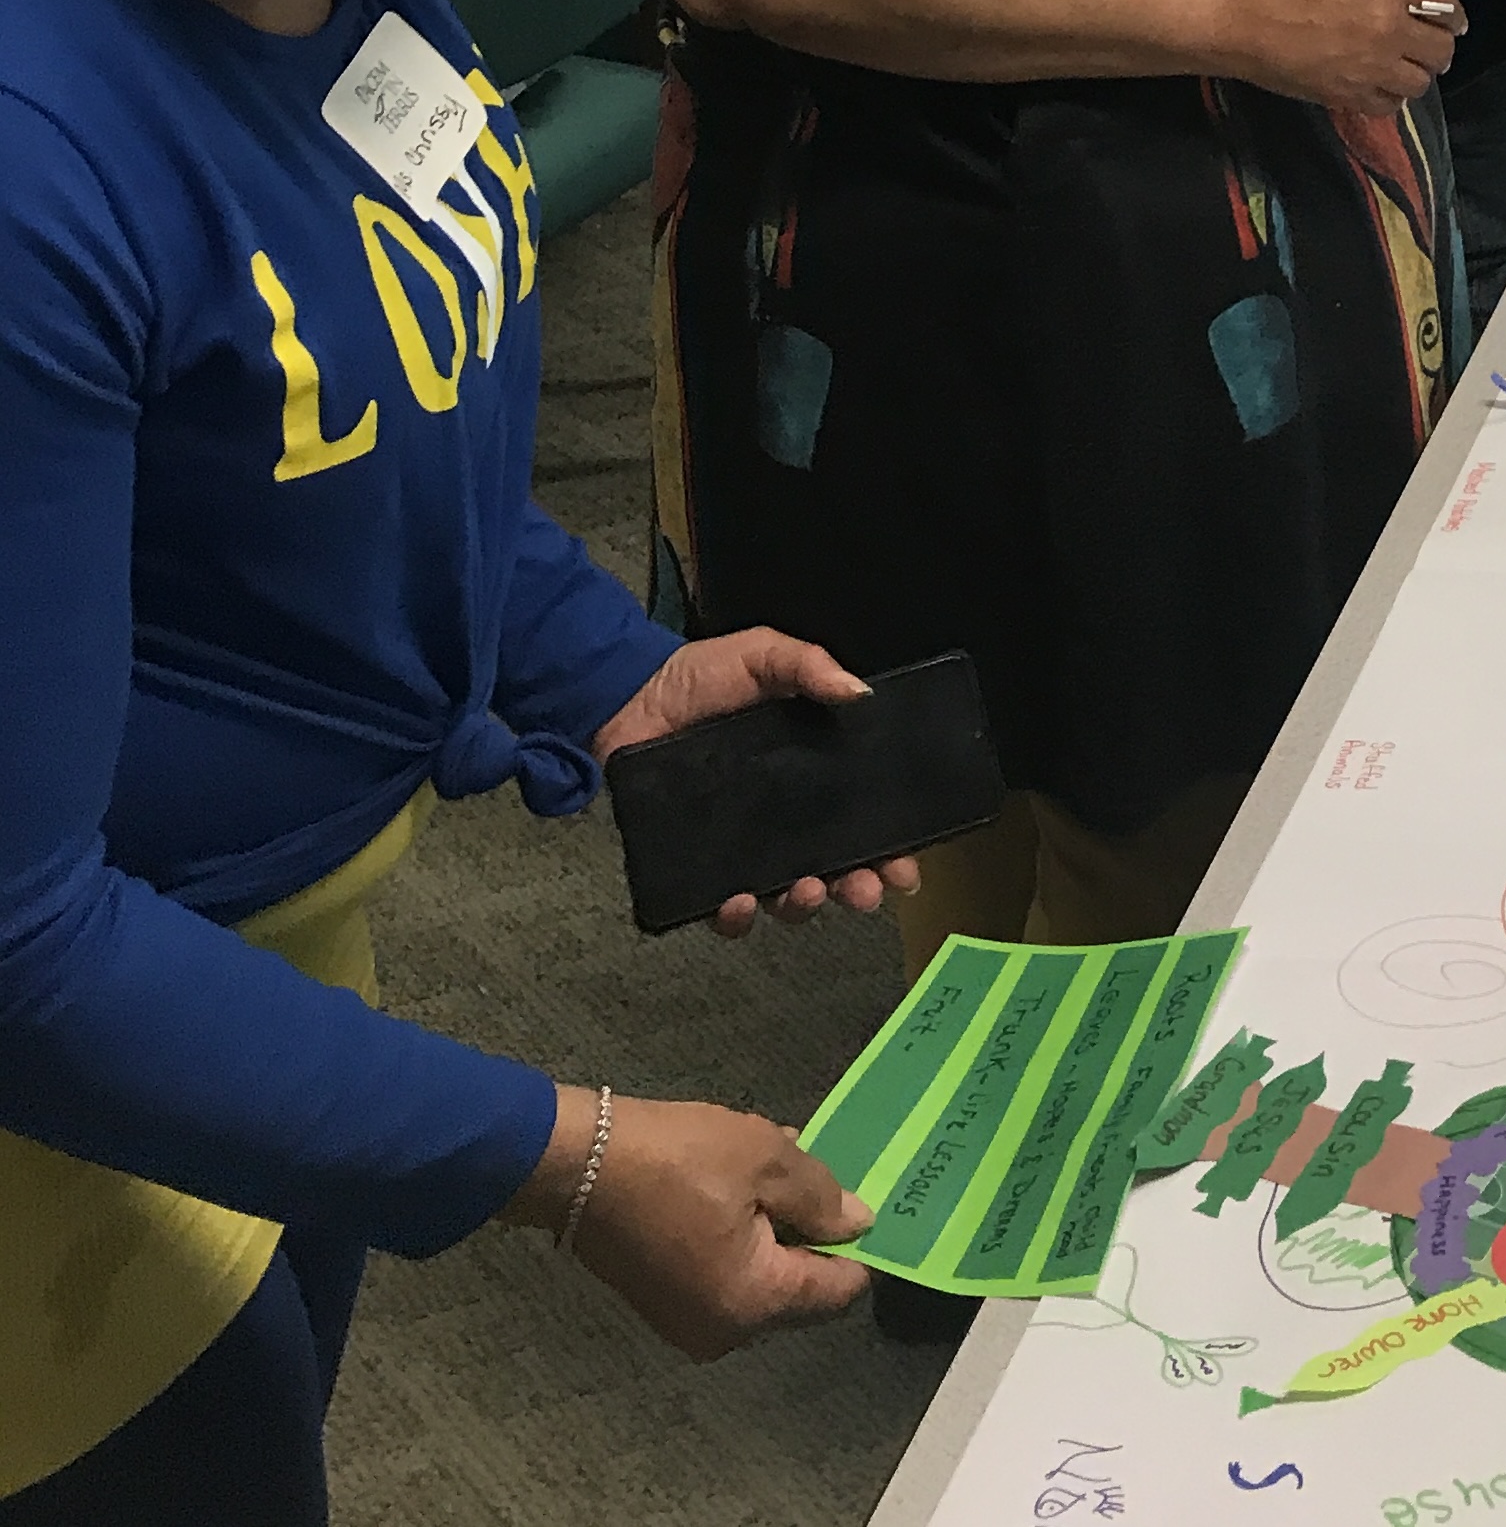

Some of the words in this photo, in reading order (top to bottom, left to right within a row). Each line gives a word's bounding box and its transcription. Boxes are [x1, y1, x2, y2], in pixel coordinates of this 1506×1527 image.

[354, 59, 391, 104] PACEM
[378, 86, 419, 135] TERRIS
[405, 93, 468, 166] Chrissy
[986, 988, 1048, 1072] Trunk
[1154, 964, 1213, 1042] Roots
[1310, 1093, 1386, 1178] Cousin
[1427, 1173, 1458, 1258] Happiness
